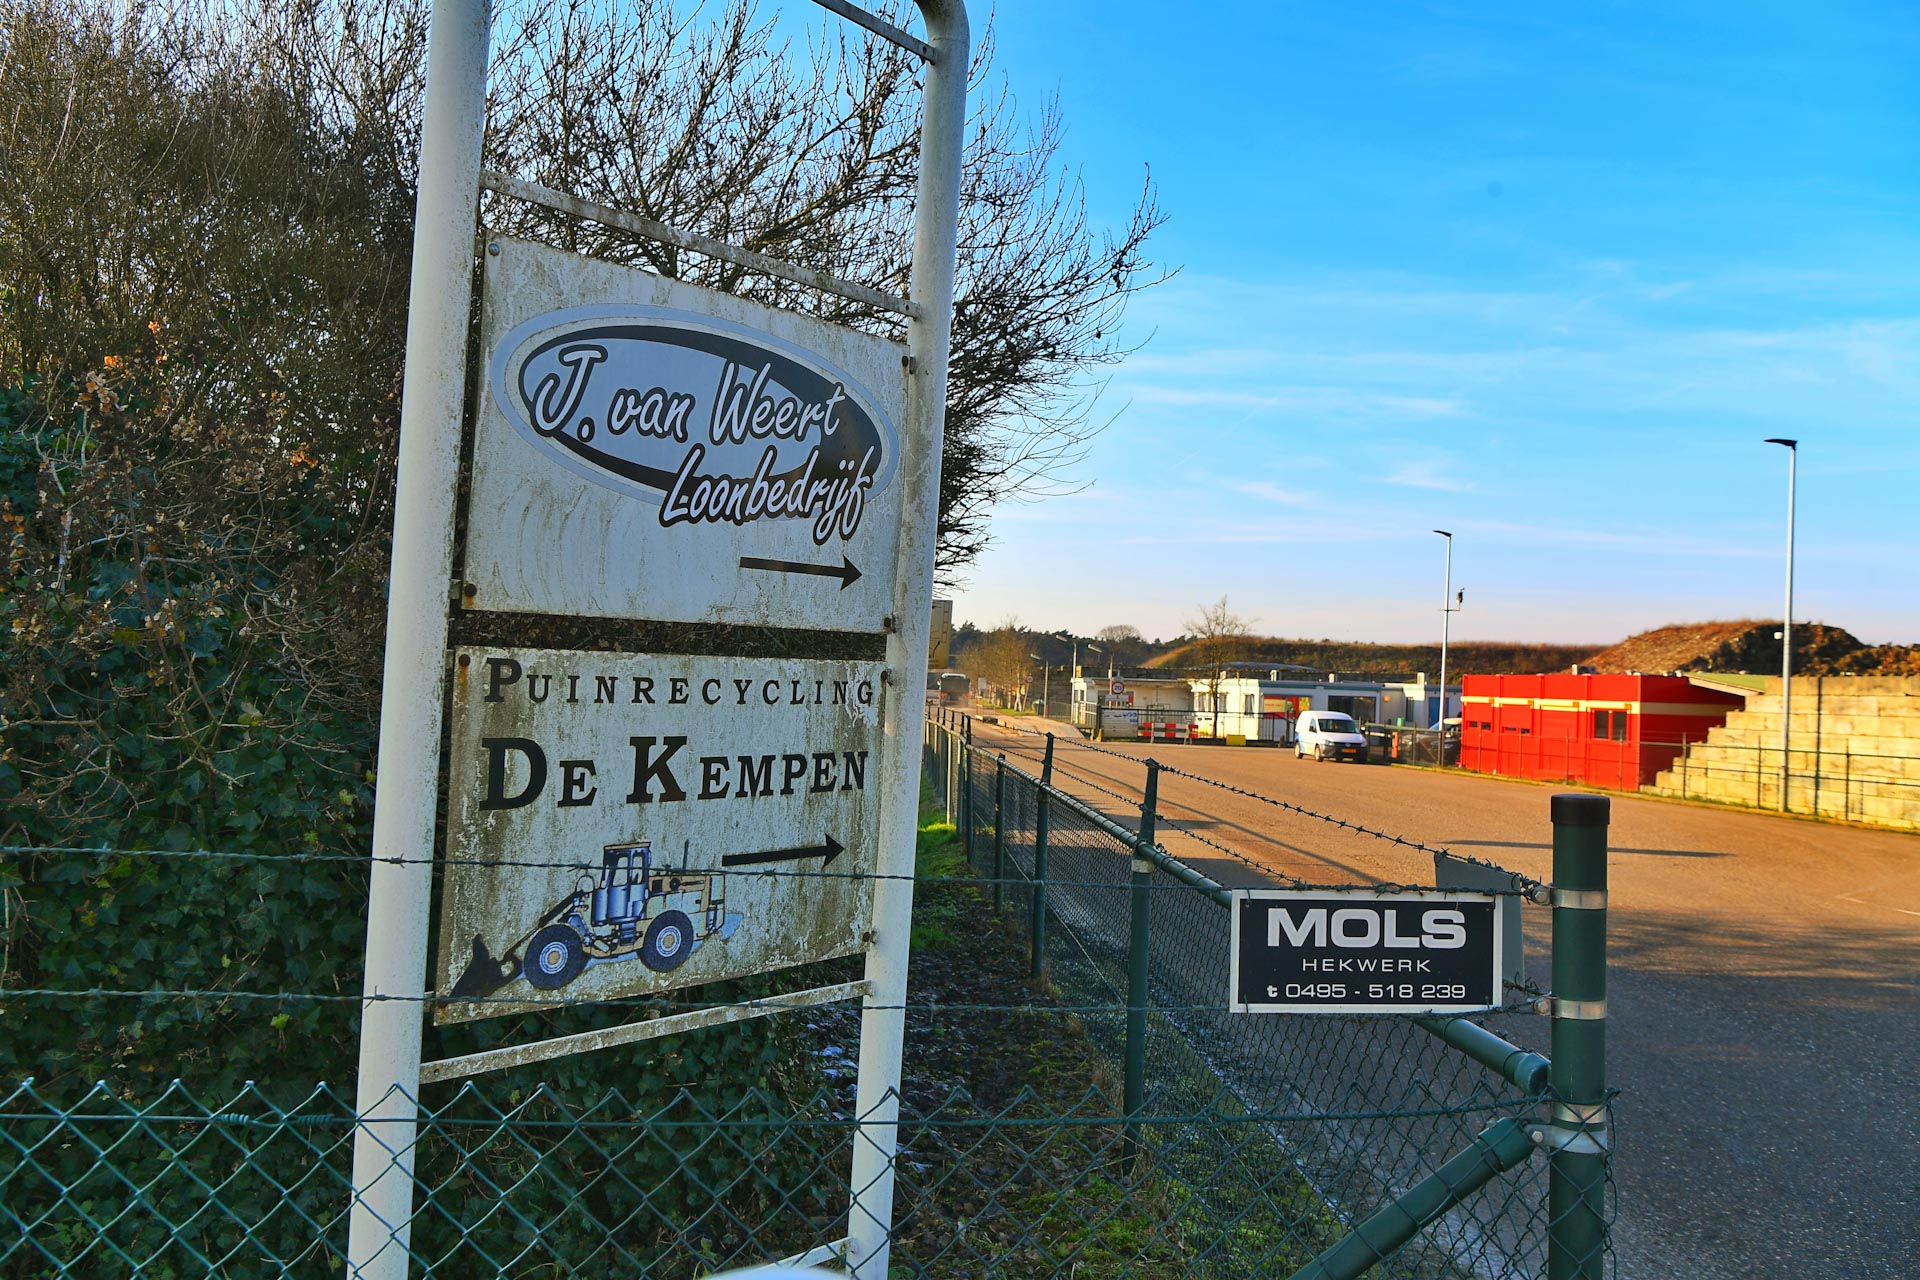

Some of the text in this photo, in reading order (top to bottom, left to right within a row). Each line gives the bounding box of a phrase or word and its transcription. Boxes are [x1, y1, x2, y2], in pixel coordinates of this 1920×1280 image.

[533, 345, 845, 444] J. van Weert
[661, 445, 874, 543] Loonbedrijf
[1267, 908, 1467, 949] MOLS
[1302, 958, 1432, 973] HEKWERK
[1285, 984, 1347, 998] 0495
[1369, 984, 1413, 999] 518
[1421, 984, 1466, 999] 239
